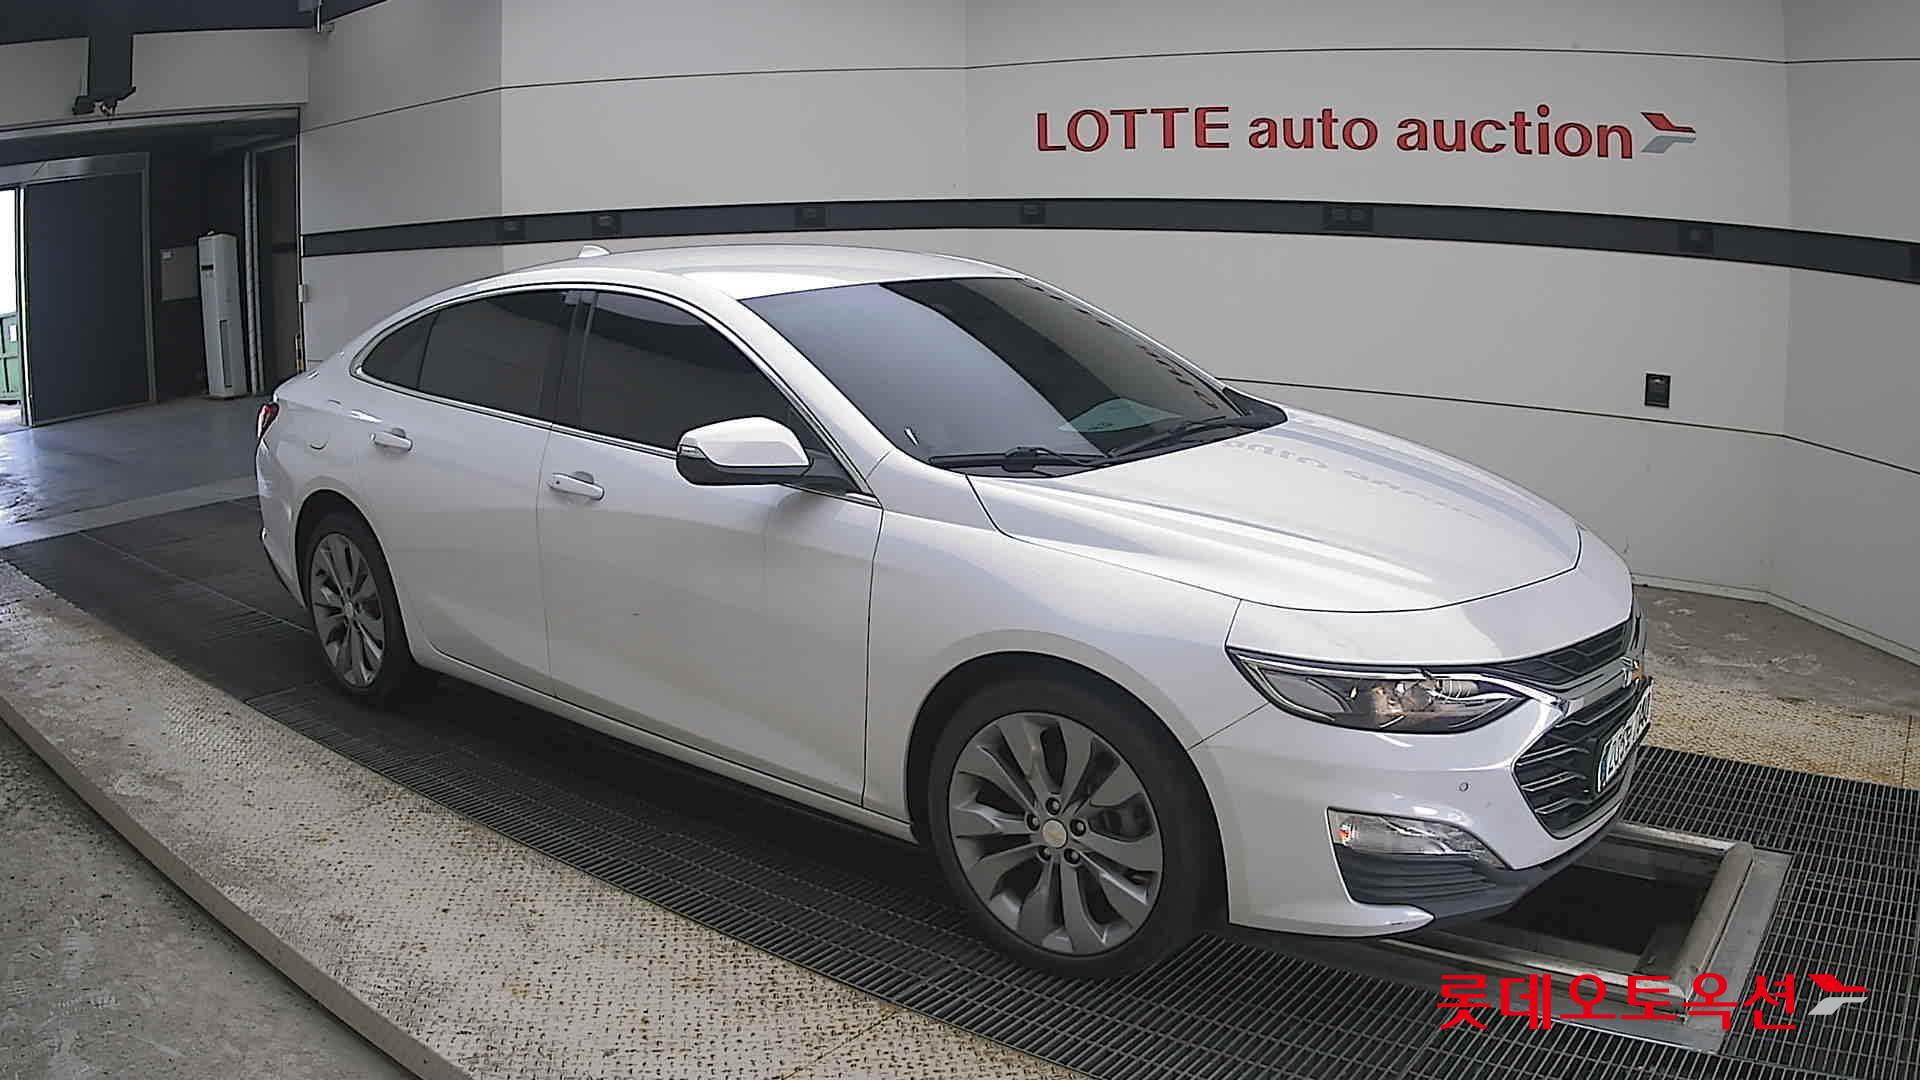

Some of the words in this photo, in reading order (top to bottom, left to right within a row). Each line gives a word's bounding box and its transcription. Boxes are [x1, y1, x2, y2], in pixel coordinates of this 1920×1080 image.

[1036, 106, 1229, 152] LOTTE
[1248, 108, 1378, 151] auto
[1396, 104, 1633, 159] auction
